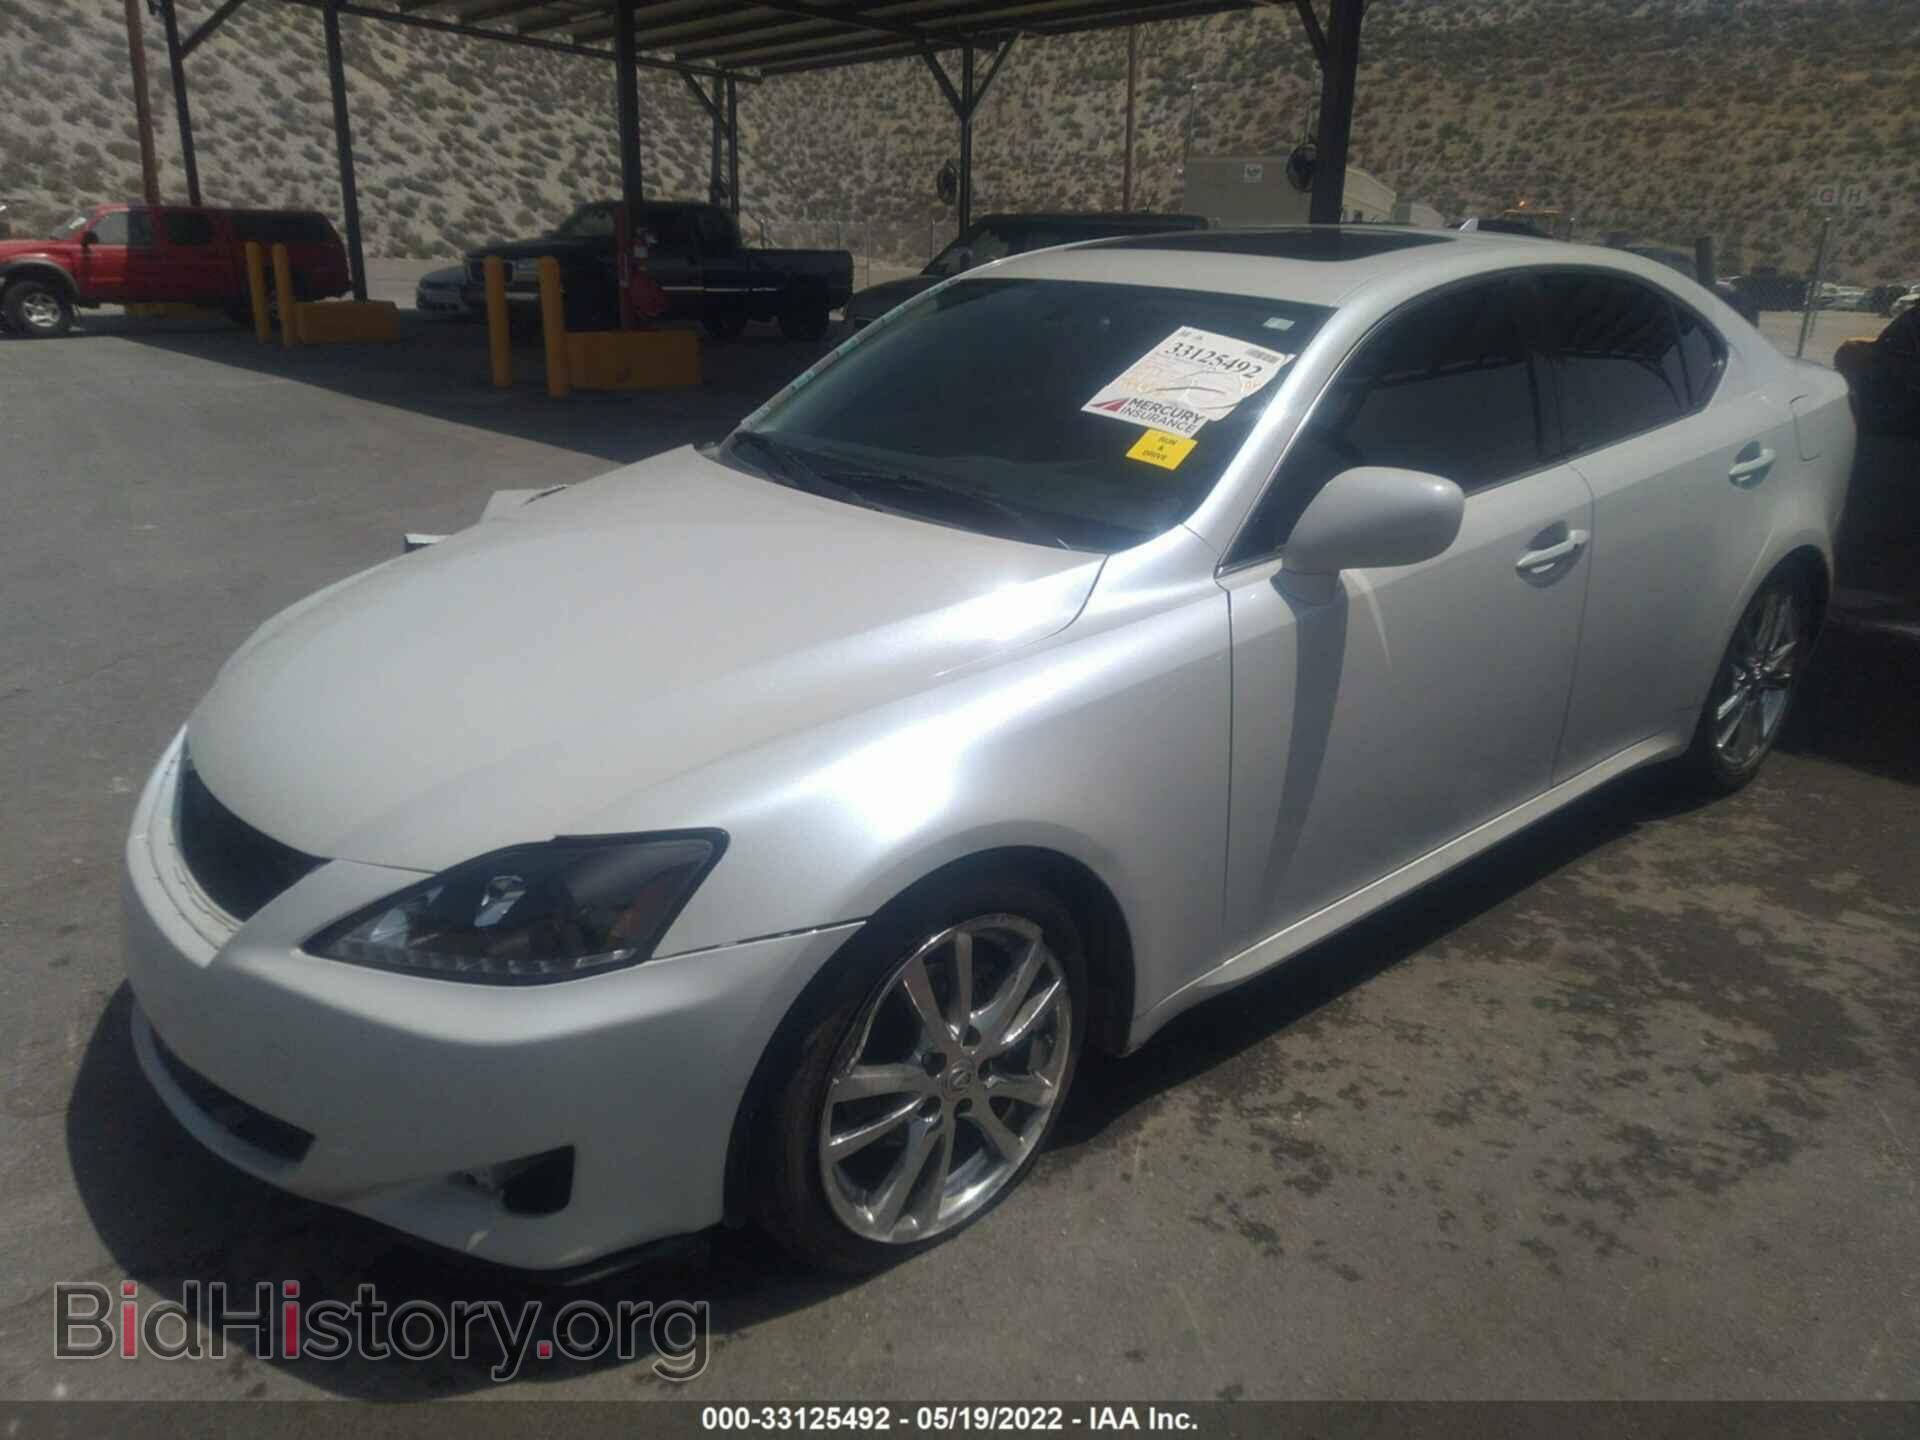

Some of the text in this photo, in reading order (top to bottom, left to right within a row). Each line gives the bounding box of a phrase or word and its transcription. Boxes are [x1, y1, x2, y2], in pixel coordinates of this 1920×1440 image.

[1164, 341, 1263, 379] 33125492
[1120, 407, 1198, 433] INSURANCE
[1127, 398, 1207, 424] MERCURY
